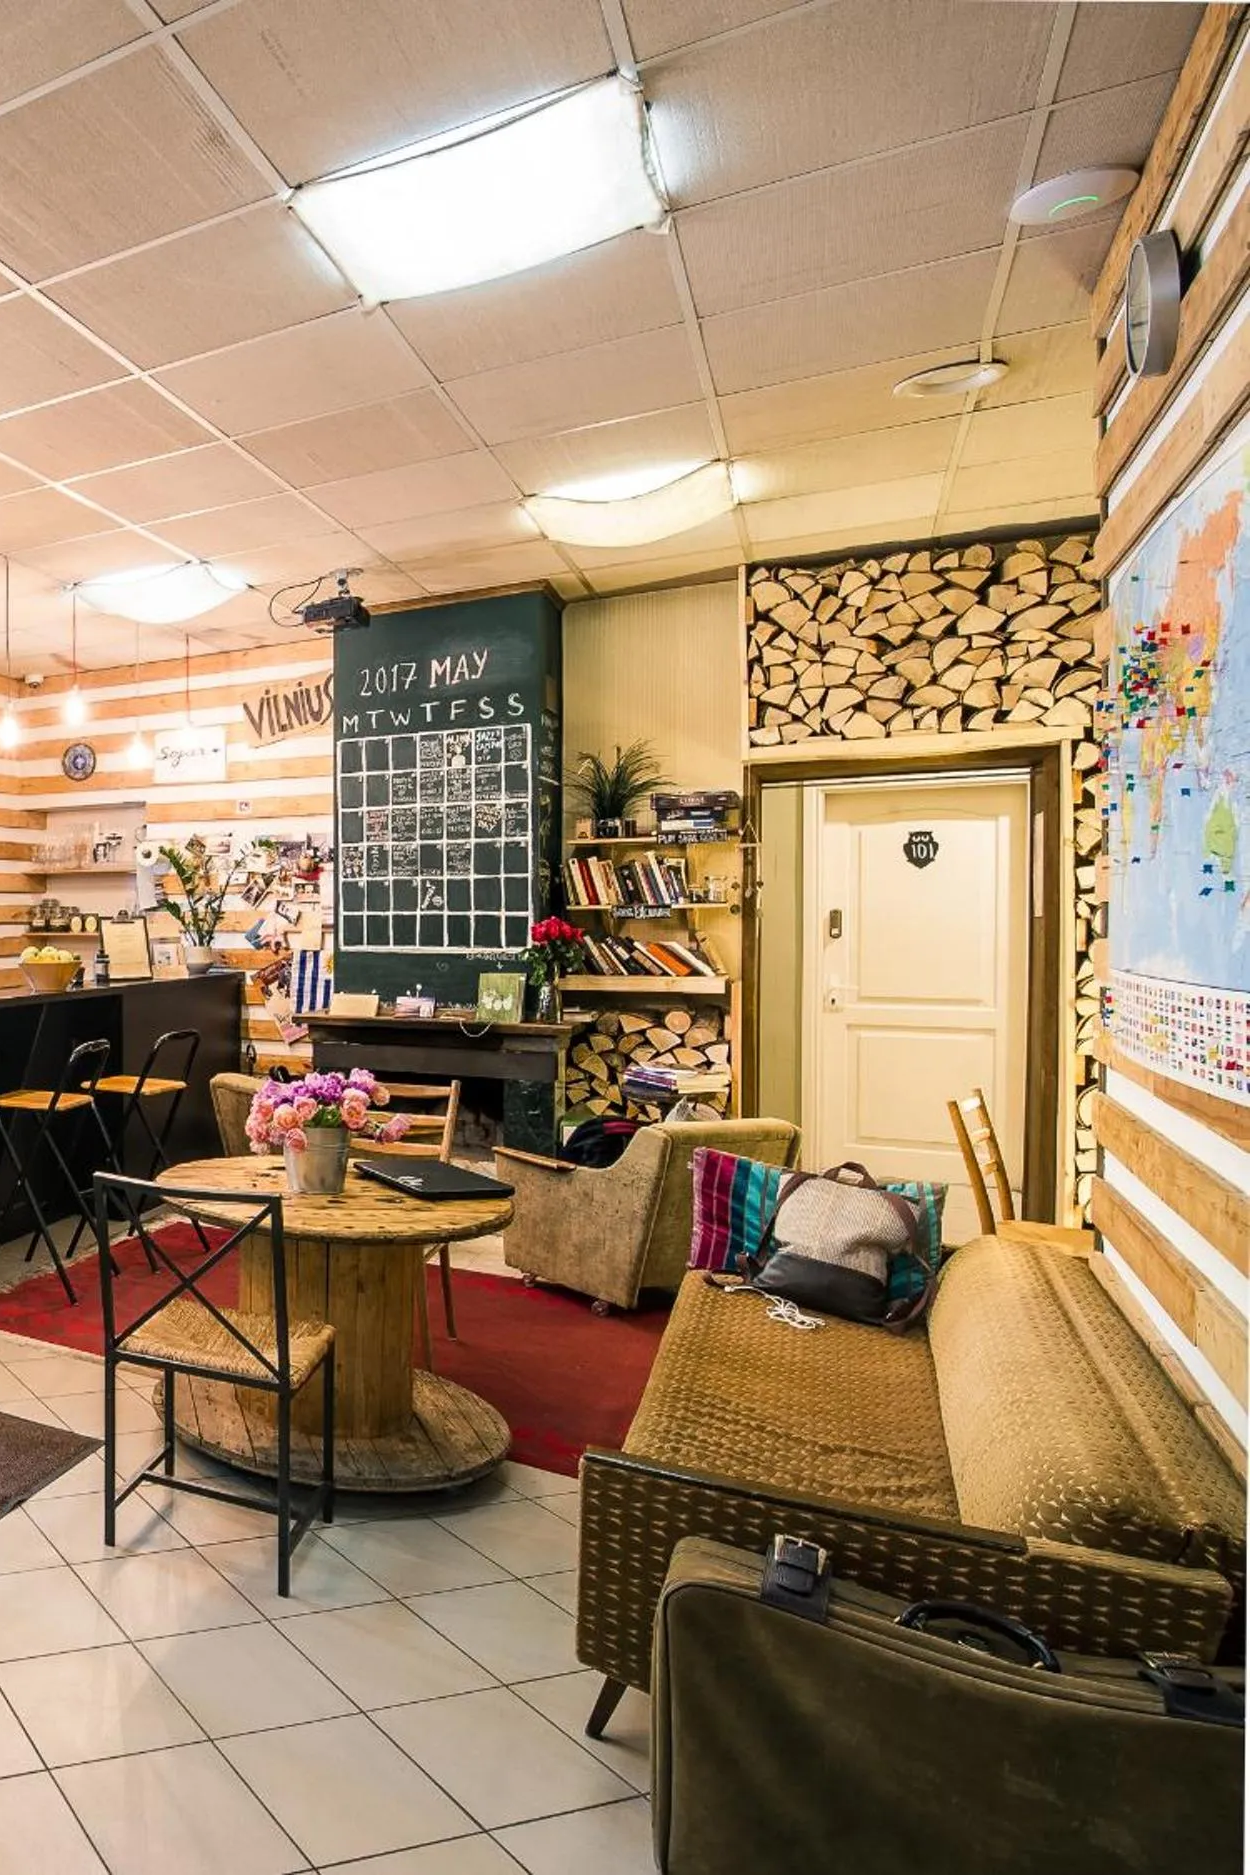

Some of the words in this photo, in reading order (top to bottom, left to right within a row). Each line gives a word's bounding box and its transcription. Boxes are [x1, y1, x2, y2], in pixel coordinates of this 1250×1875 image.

[359, 662, 418, 697] 2017
[429, 648, 488, 689] MAY
[342, 714, 359, 734] M
[366, 709, 385, 729] T
[389, 708, 411, 727] W
[419, 701, 440, 723] T
[449, 699, 467, 721] F
[478, 696, 495, 719] S
[507, 692, 525, 717] S
[911, 843, 934, 859] 101
